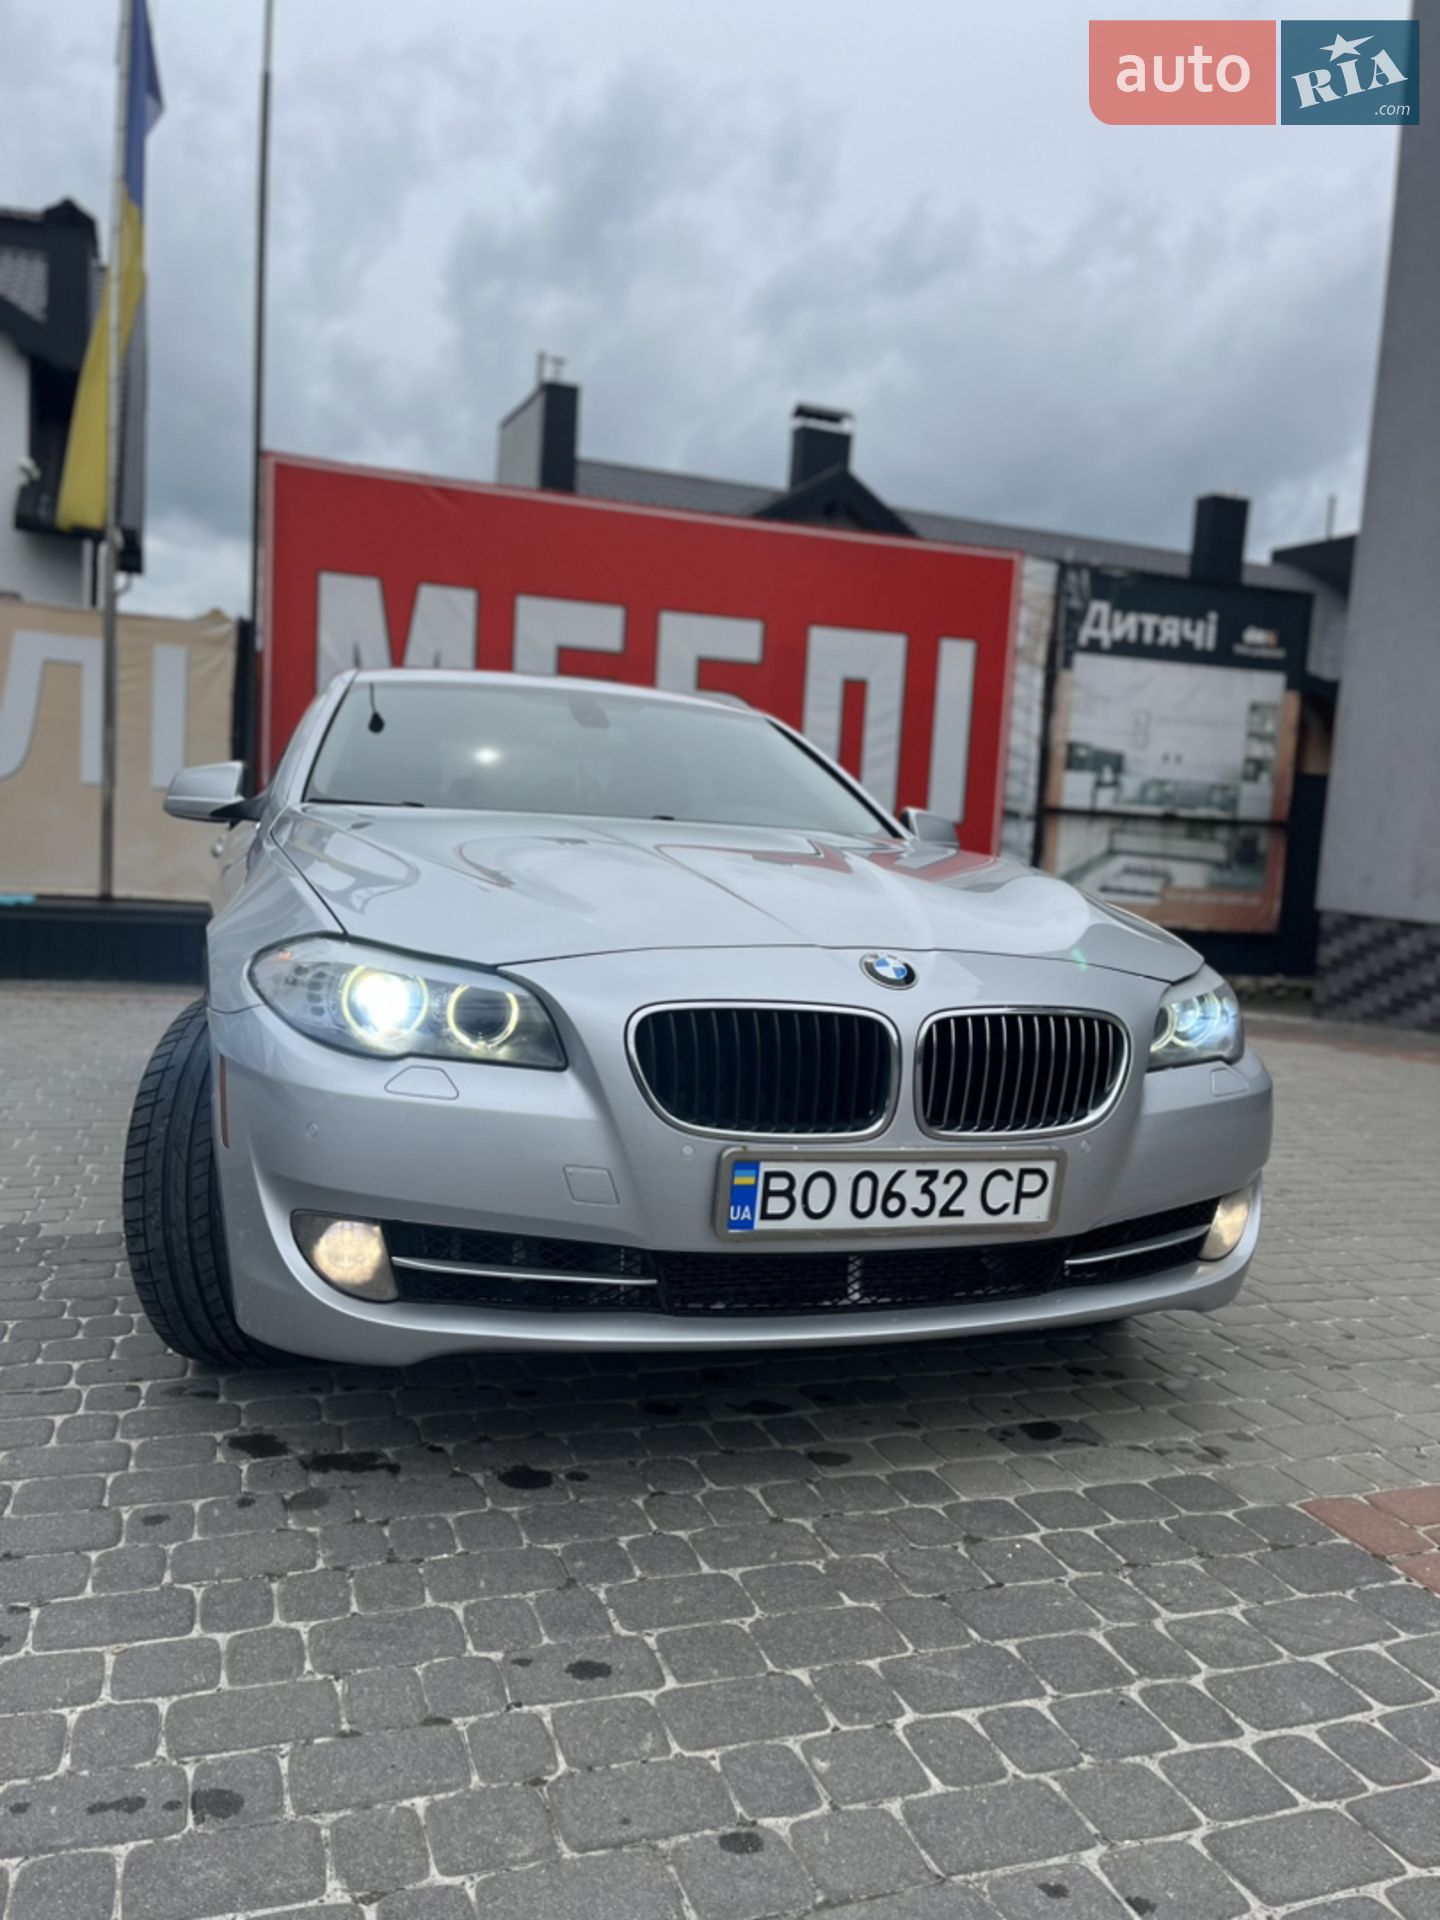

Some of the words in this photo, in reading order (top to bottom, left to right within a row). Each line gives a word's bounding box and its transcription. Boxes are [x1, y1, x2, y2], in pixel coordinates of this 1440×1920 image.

[1077, 600, 1219, 652] Дитячі
[729, 1205, 752, 1221] UA
[759, 1169, 837, 1221] BO
[849, 1168, 969, 1220] 0632
[979, 1167, 1049, 1217] CP
